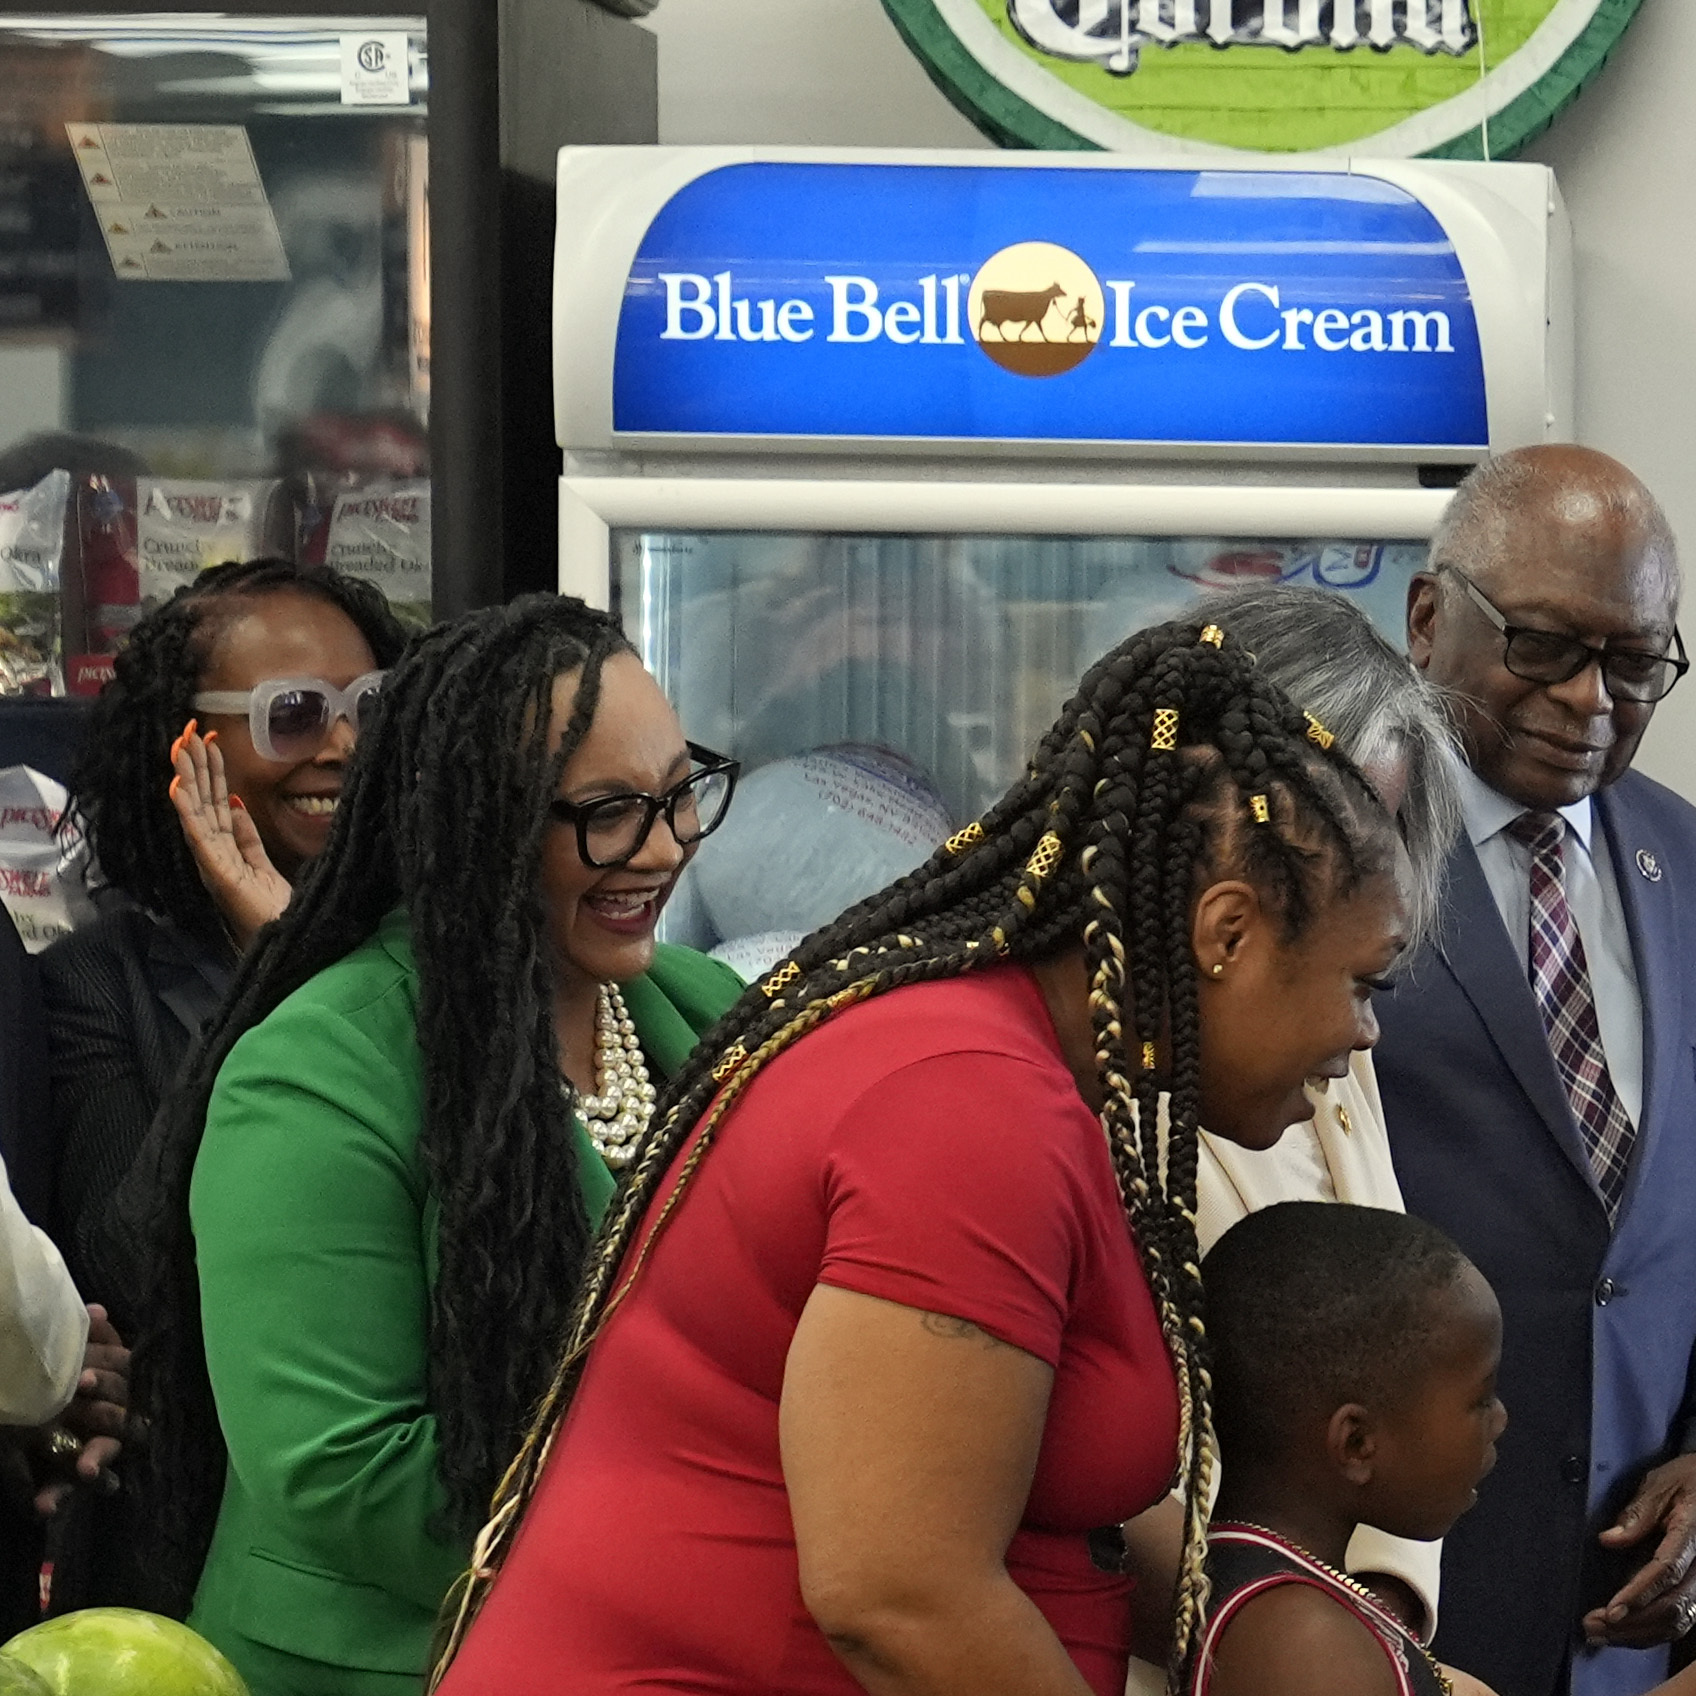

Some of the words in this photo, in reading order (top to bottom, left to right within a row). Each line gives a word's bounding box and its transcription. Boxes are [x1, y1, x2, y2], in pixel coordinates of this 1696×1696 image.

[658, 271, 813, 343] Blue
[826, 275, 965, 345] Bell
[1109, 281, 1207, 349] Ice
[1219, 282, 1454, 353] Cream
